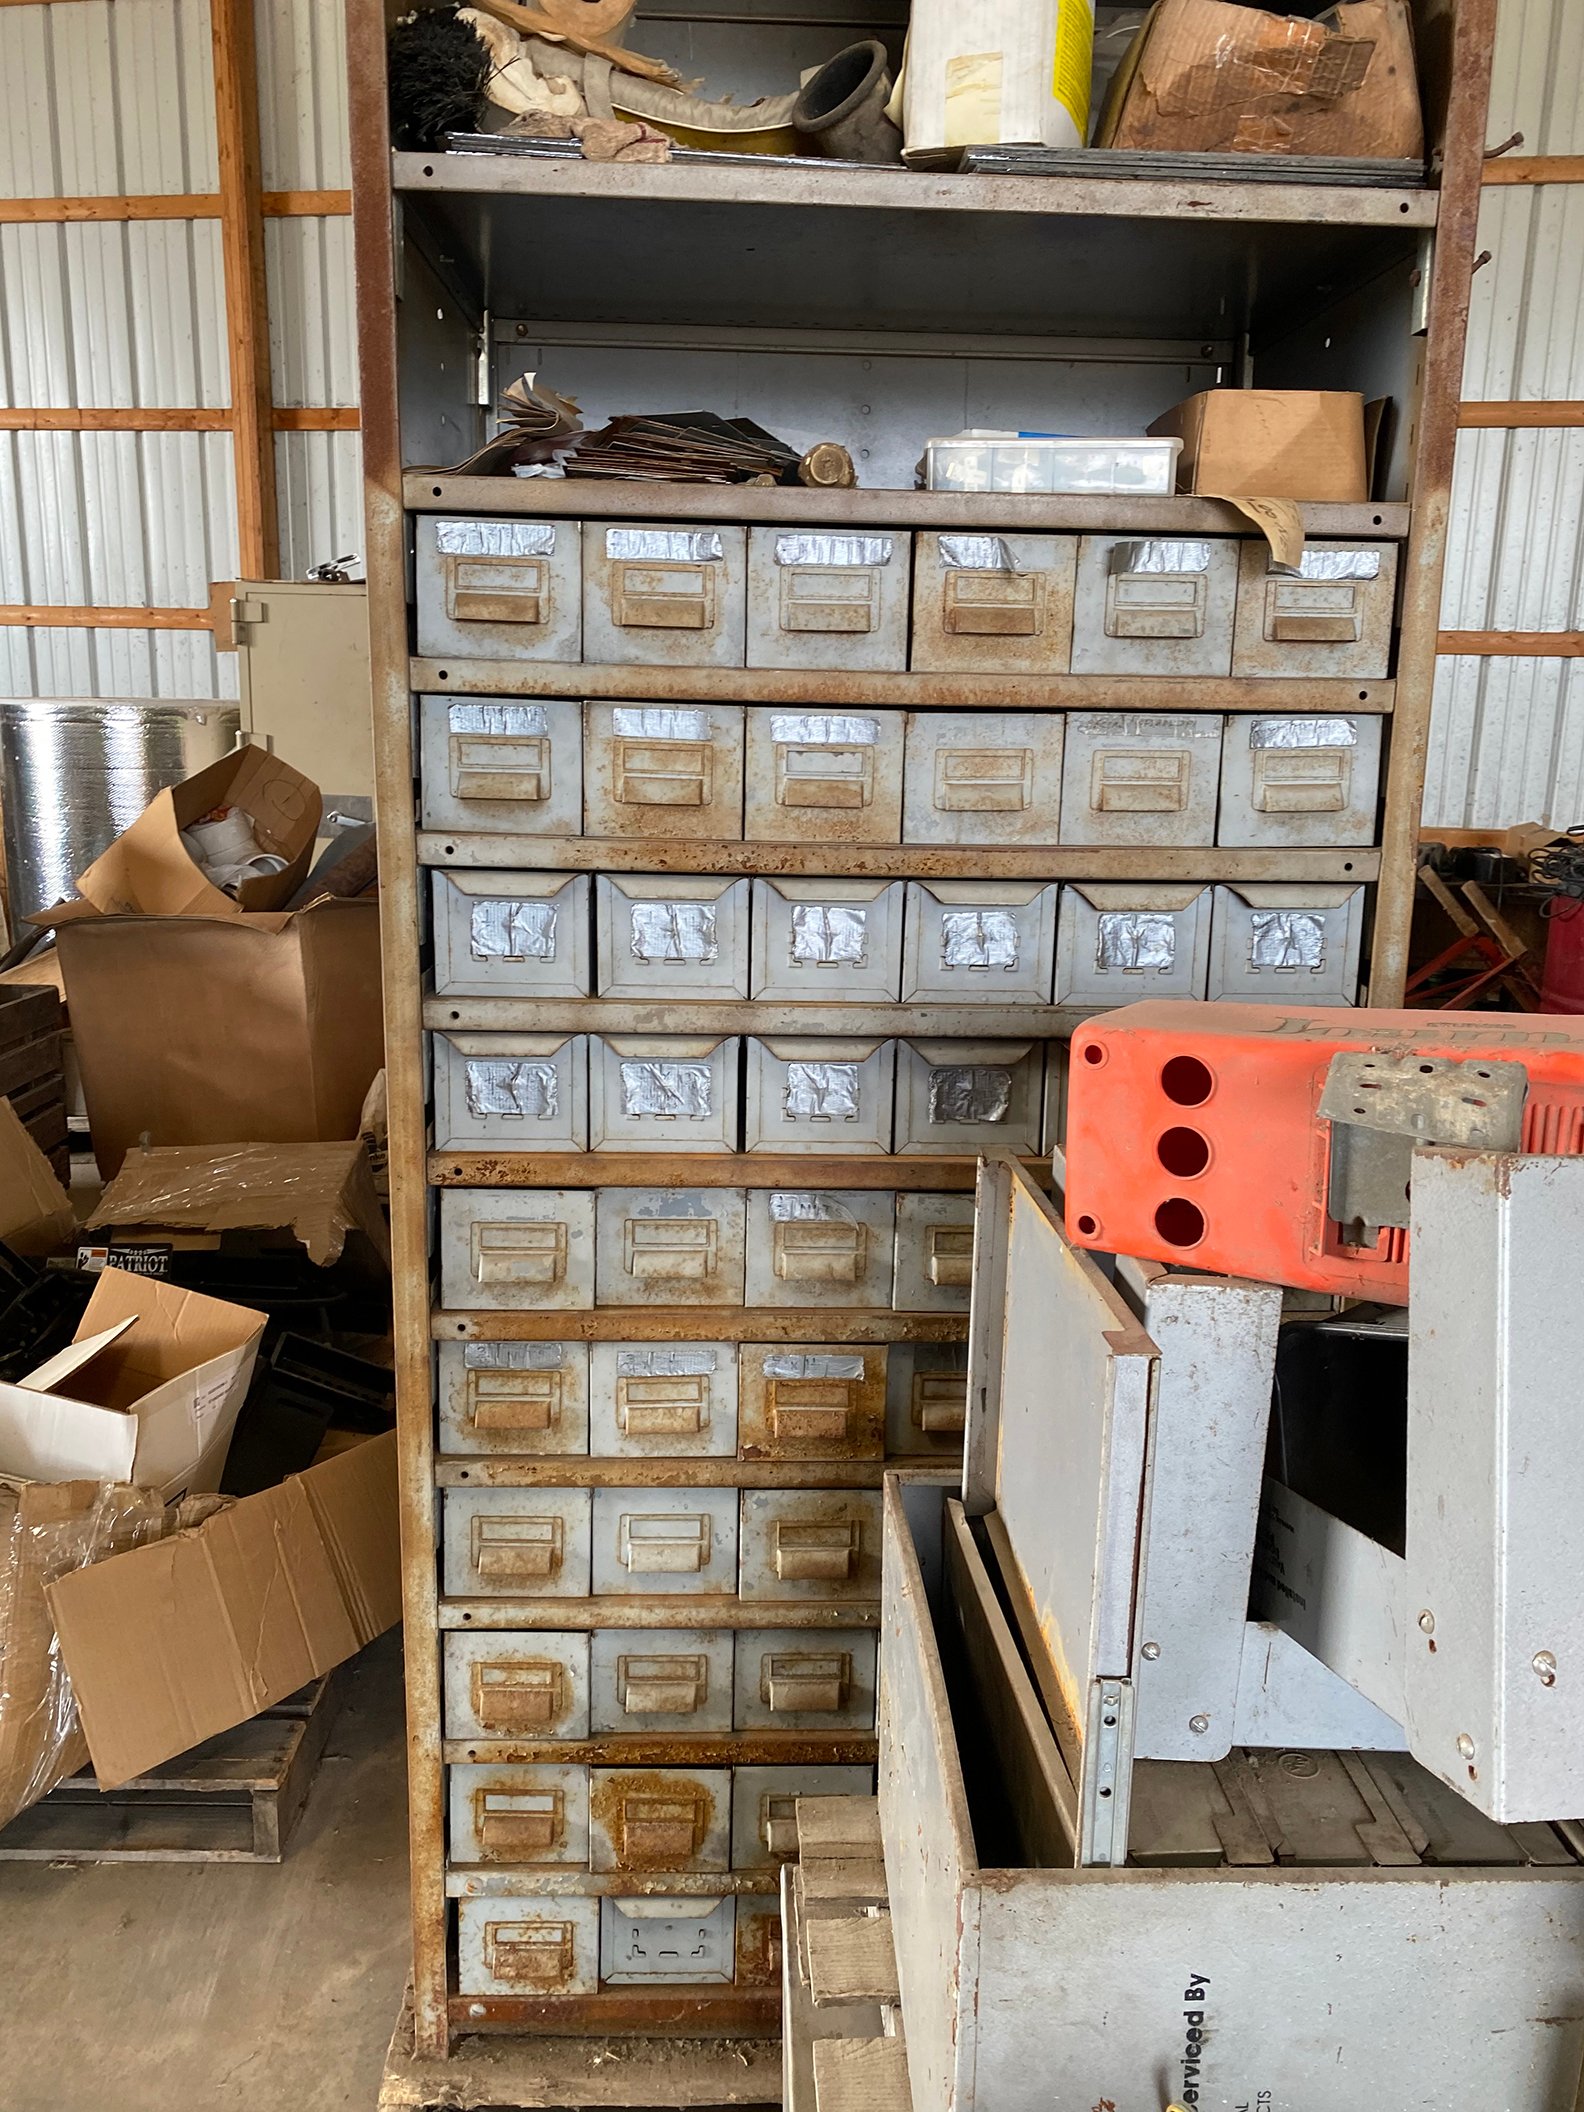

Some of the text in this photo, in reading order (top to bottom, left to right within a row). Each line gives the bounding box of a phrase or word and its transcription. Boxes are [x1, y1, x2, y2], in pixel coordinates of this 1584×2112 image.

[1256, 1016, 1584, 1045] Journ
[109, 1255, 168, 1272] PATRIOT
[1180, 1973, 1211, 2112] erviced By
